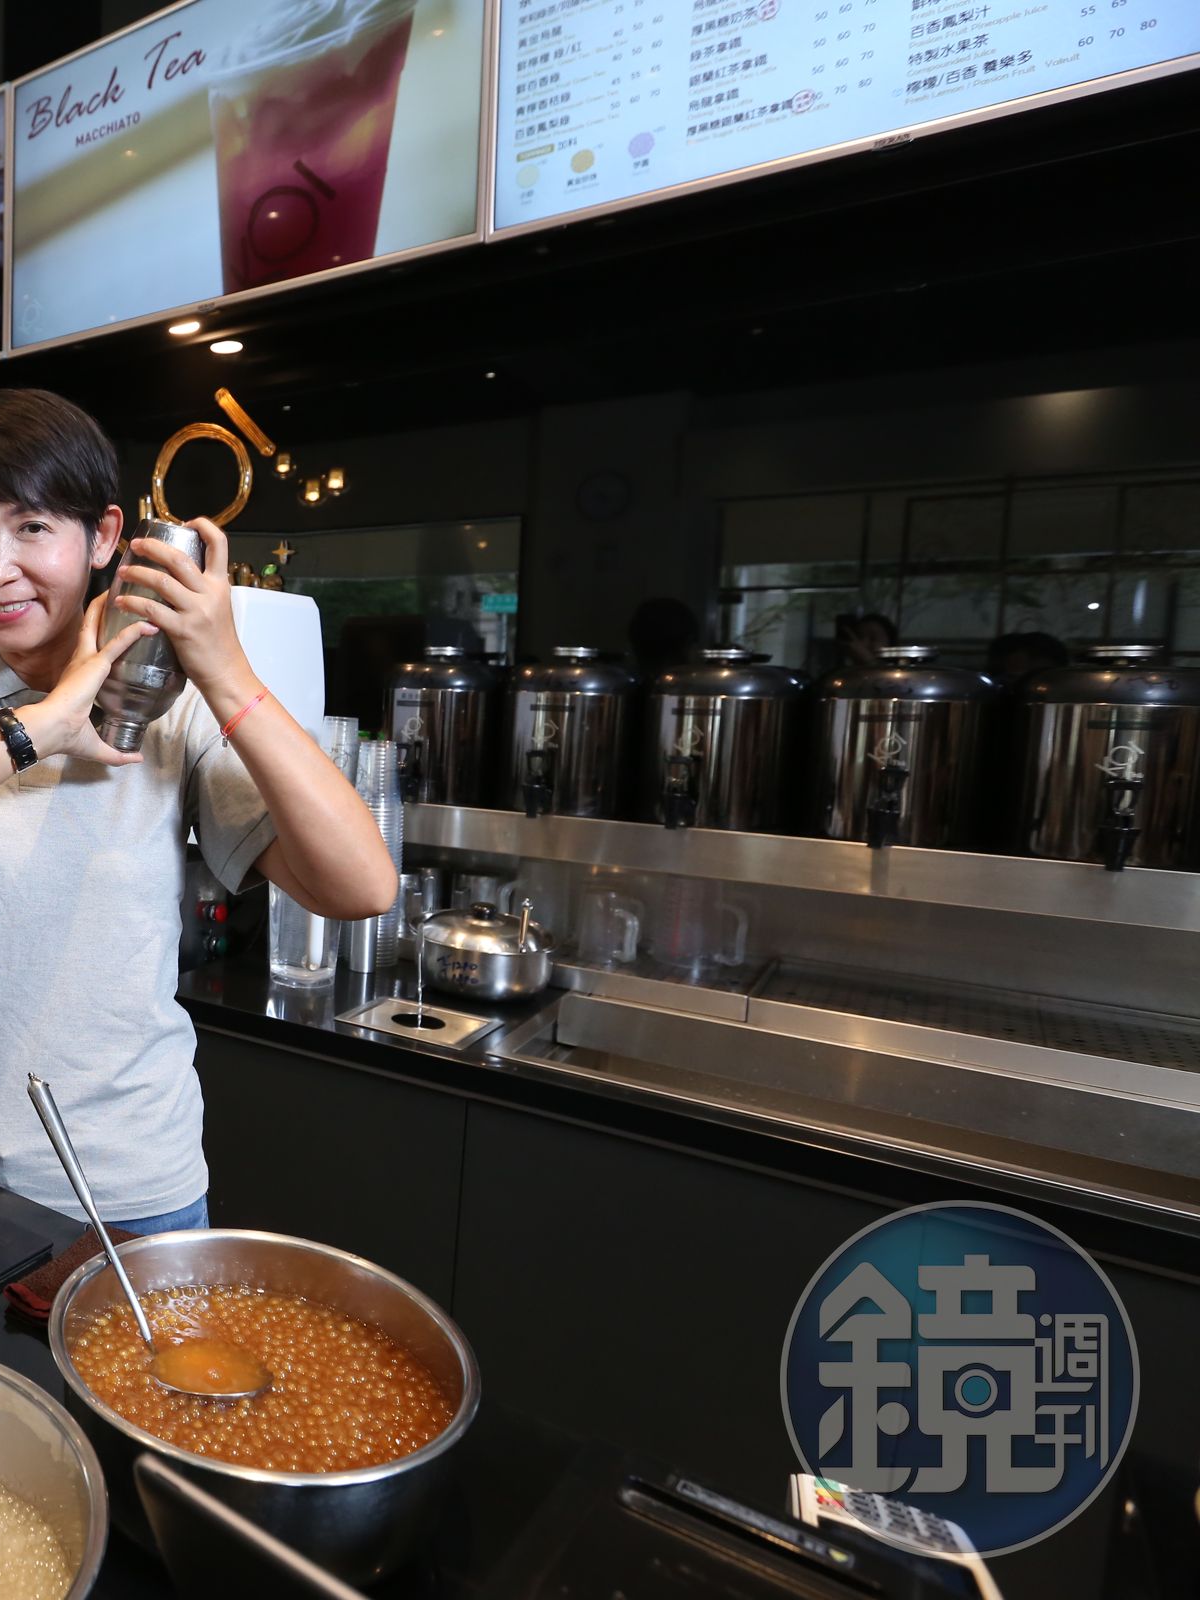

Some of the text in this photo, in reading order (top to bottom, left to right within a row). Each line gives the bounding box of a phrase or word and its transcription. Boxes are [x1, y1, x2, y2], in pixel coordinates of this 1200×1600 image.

[863, 22, 877, 33] 70
[911, 5, 991, 39] 百香鳳梨汁
[1024, 4, 1050, 18] Juice
[908, 33, 990, 66] 特製水果茶
[1080, 5, 1096, 17] 55
[983, 49, 1033, 74] 養樂多
[1078, 36, 1094, 47] 60
[1109, 27, 1125, 39] 70
[1140, 18, 1157, 31] 80
[860, 50, 874, 61] 70
[25, 31, 206, 140] Black Tea
[74, 111, 141, 148] MACCHIATO
